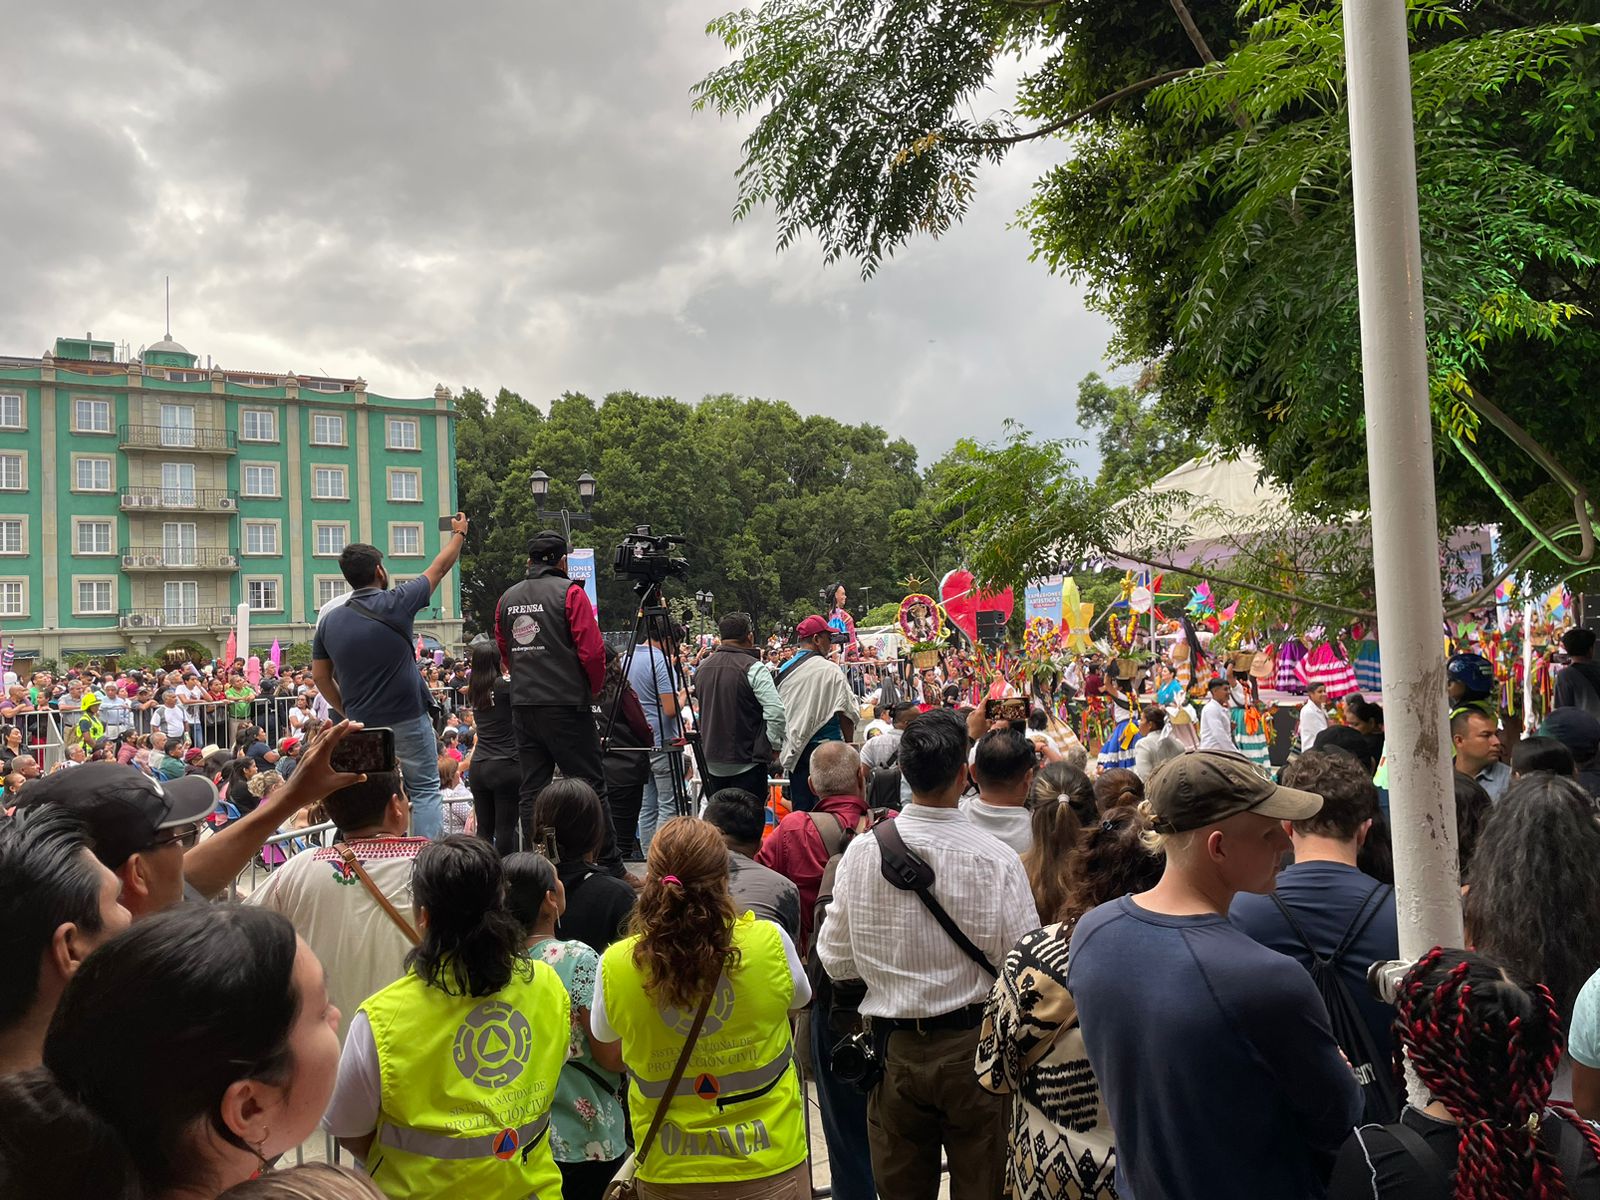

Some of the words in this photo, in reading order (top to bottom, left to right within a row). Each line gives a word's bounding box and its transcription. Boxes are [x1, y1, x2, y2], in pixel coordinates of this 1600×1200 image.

[507, 604, 544, 615] PRENSA
[590, 705, 602, 713] SA
[728, 1049, 759, 1064] CIVIL
[534, 1080, 546, 1092] DE
[660, 1119, 771, 1156] OAXACA
